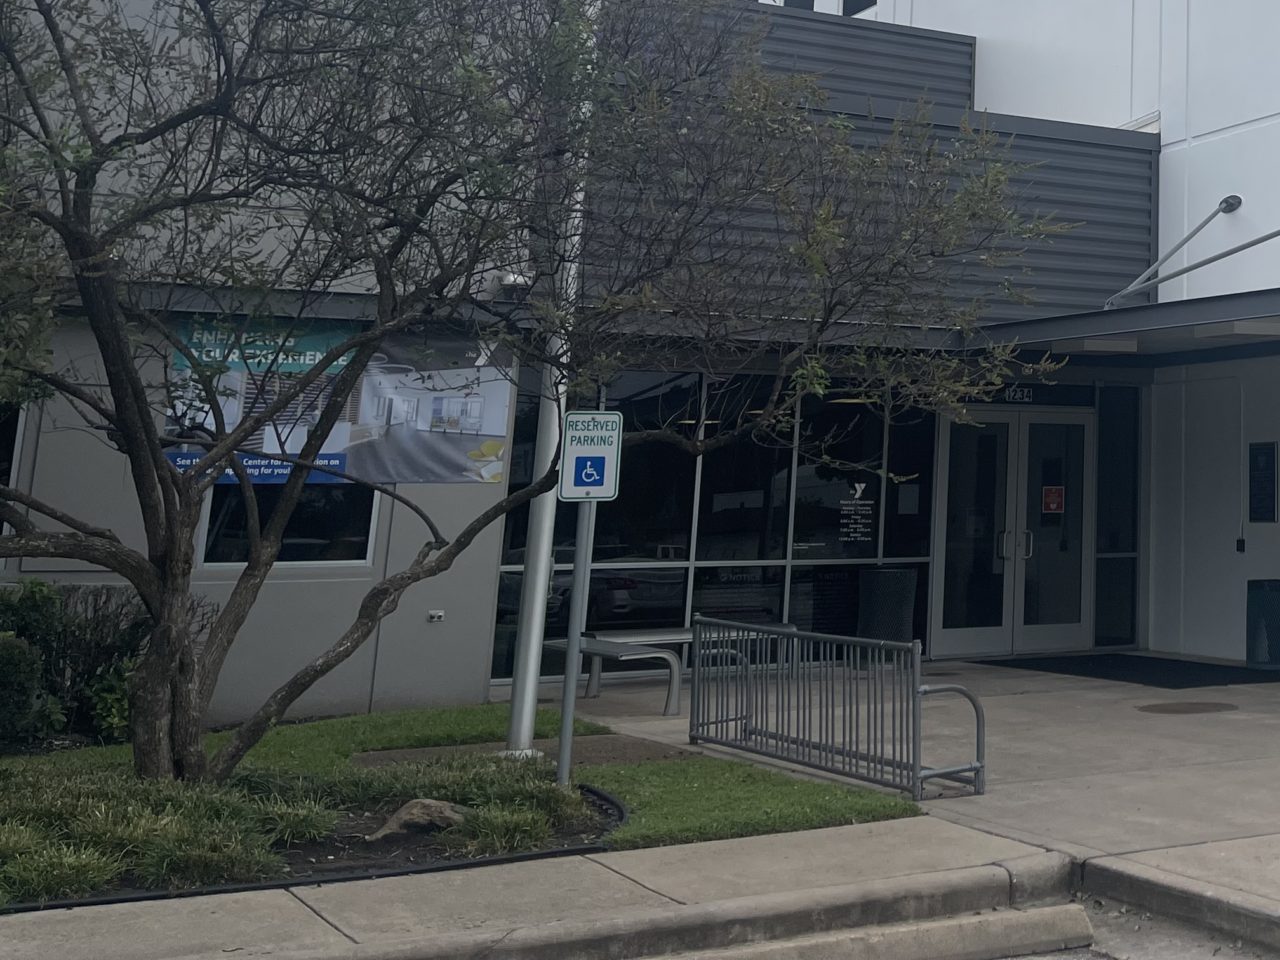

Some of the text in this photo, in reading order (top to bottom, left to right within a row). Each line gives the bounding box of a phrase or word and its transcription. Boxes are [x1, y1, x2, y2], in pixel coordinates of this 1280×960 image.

[244, 349, 348, 365] EXPERIENE
[568, 420, 618, 431] RESERVED
[570, 435, 614, 446] PARKING
[243, 458, 269, 466] Center
[260, 467, 272, 475] for
